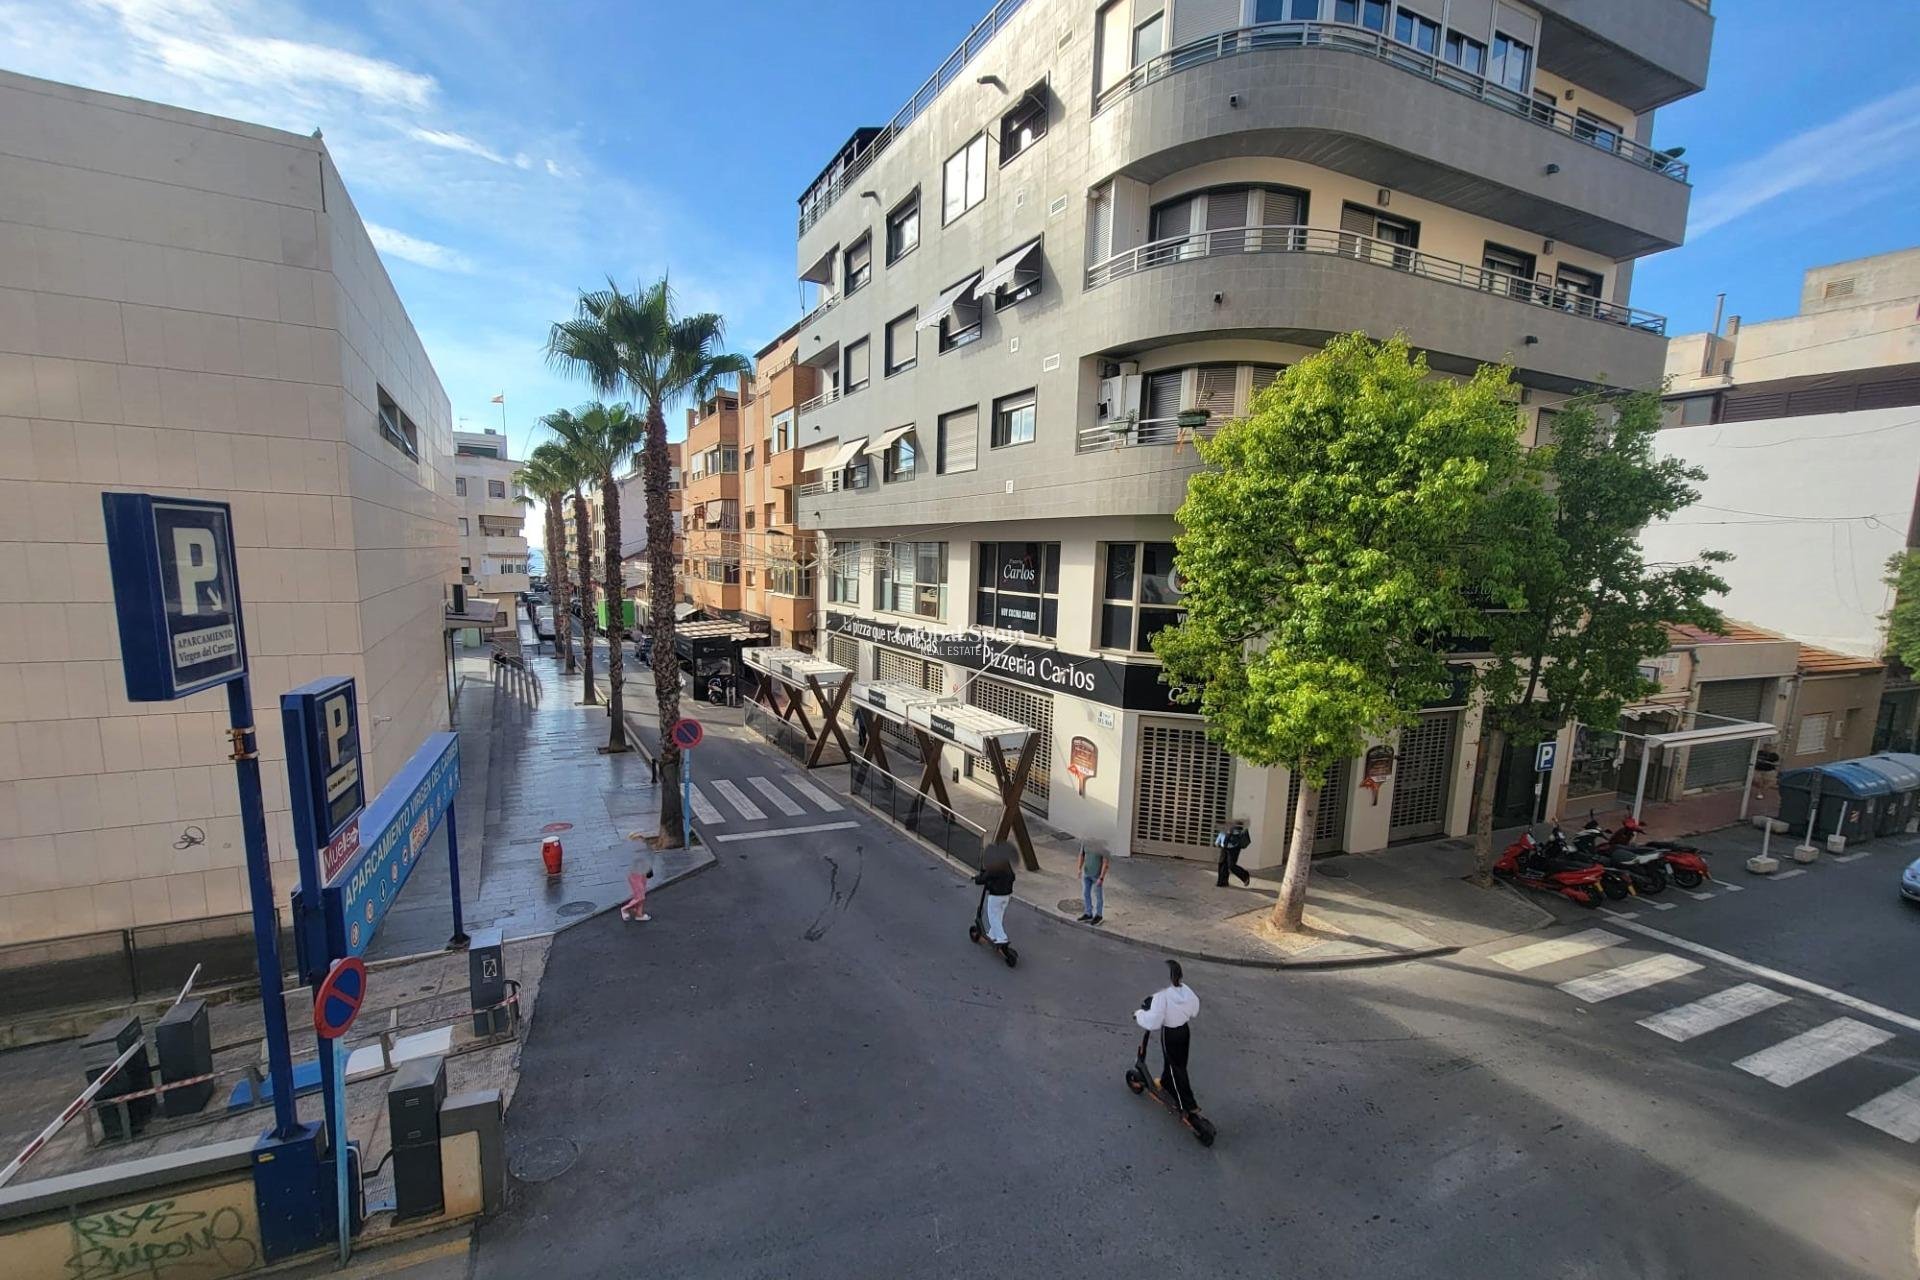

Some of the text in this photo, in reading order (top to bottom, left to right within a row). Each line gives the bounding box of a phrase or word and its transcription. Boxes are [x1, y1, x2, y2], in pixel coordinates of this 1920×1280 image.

[172, 527, 218, 616] P
[1003, 564, 1035, 581] Carlos
[177, 629, 234, 649] APARCAMIENTO
[852, 620, 871, 636] pizza
[872, 624, 886, 642] que
[178, 651, 201, 664] Virgen
[202, 645, 213, 657] del
[982, 644, 1096, 692] Pizzería Carlos
[324, 694, 349, 769] P
[1540, 745, 1554, 768] P
[345, 807, 410, 912] APARCAMIENTO
[410, 776, 431, 817] VIRGEN
[431, 764, 442, 788] DEL
